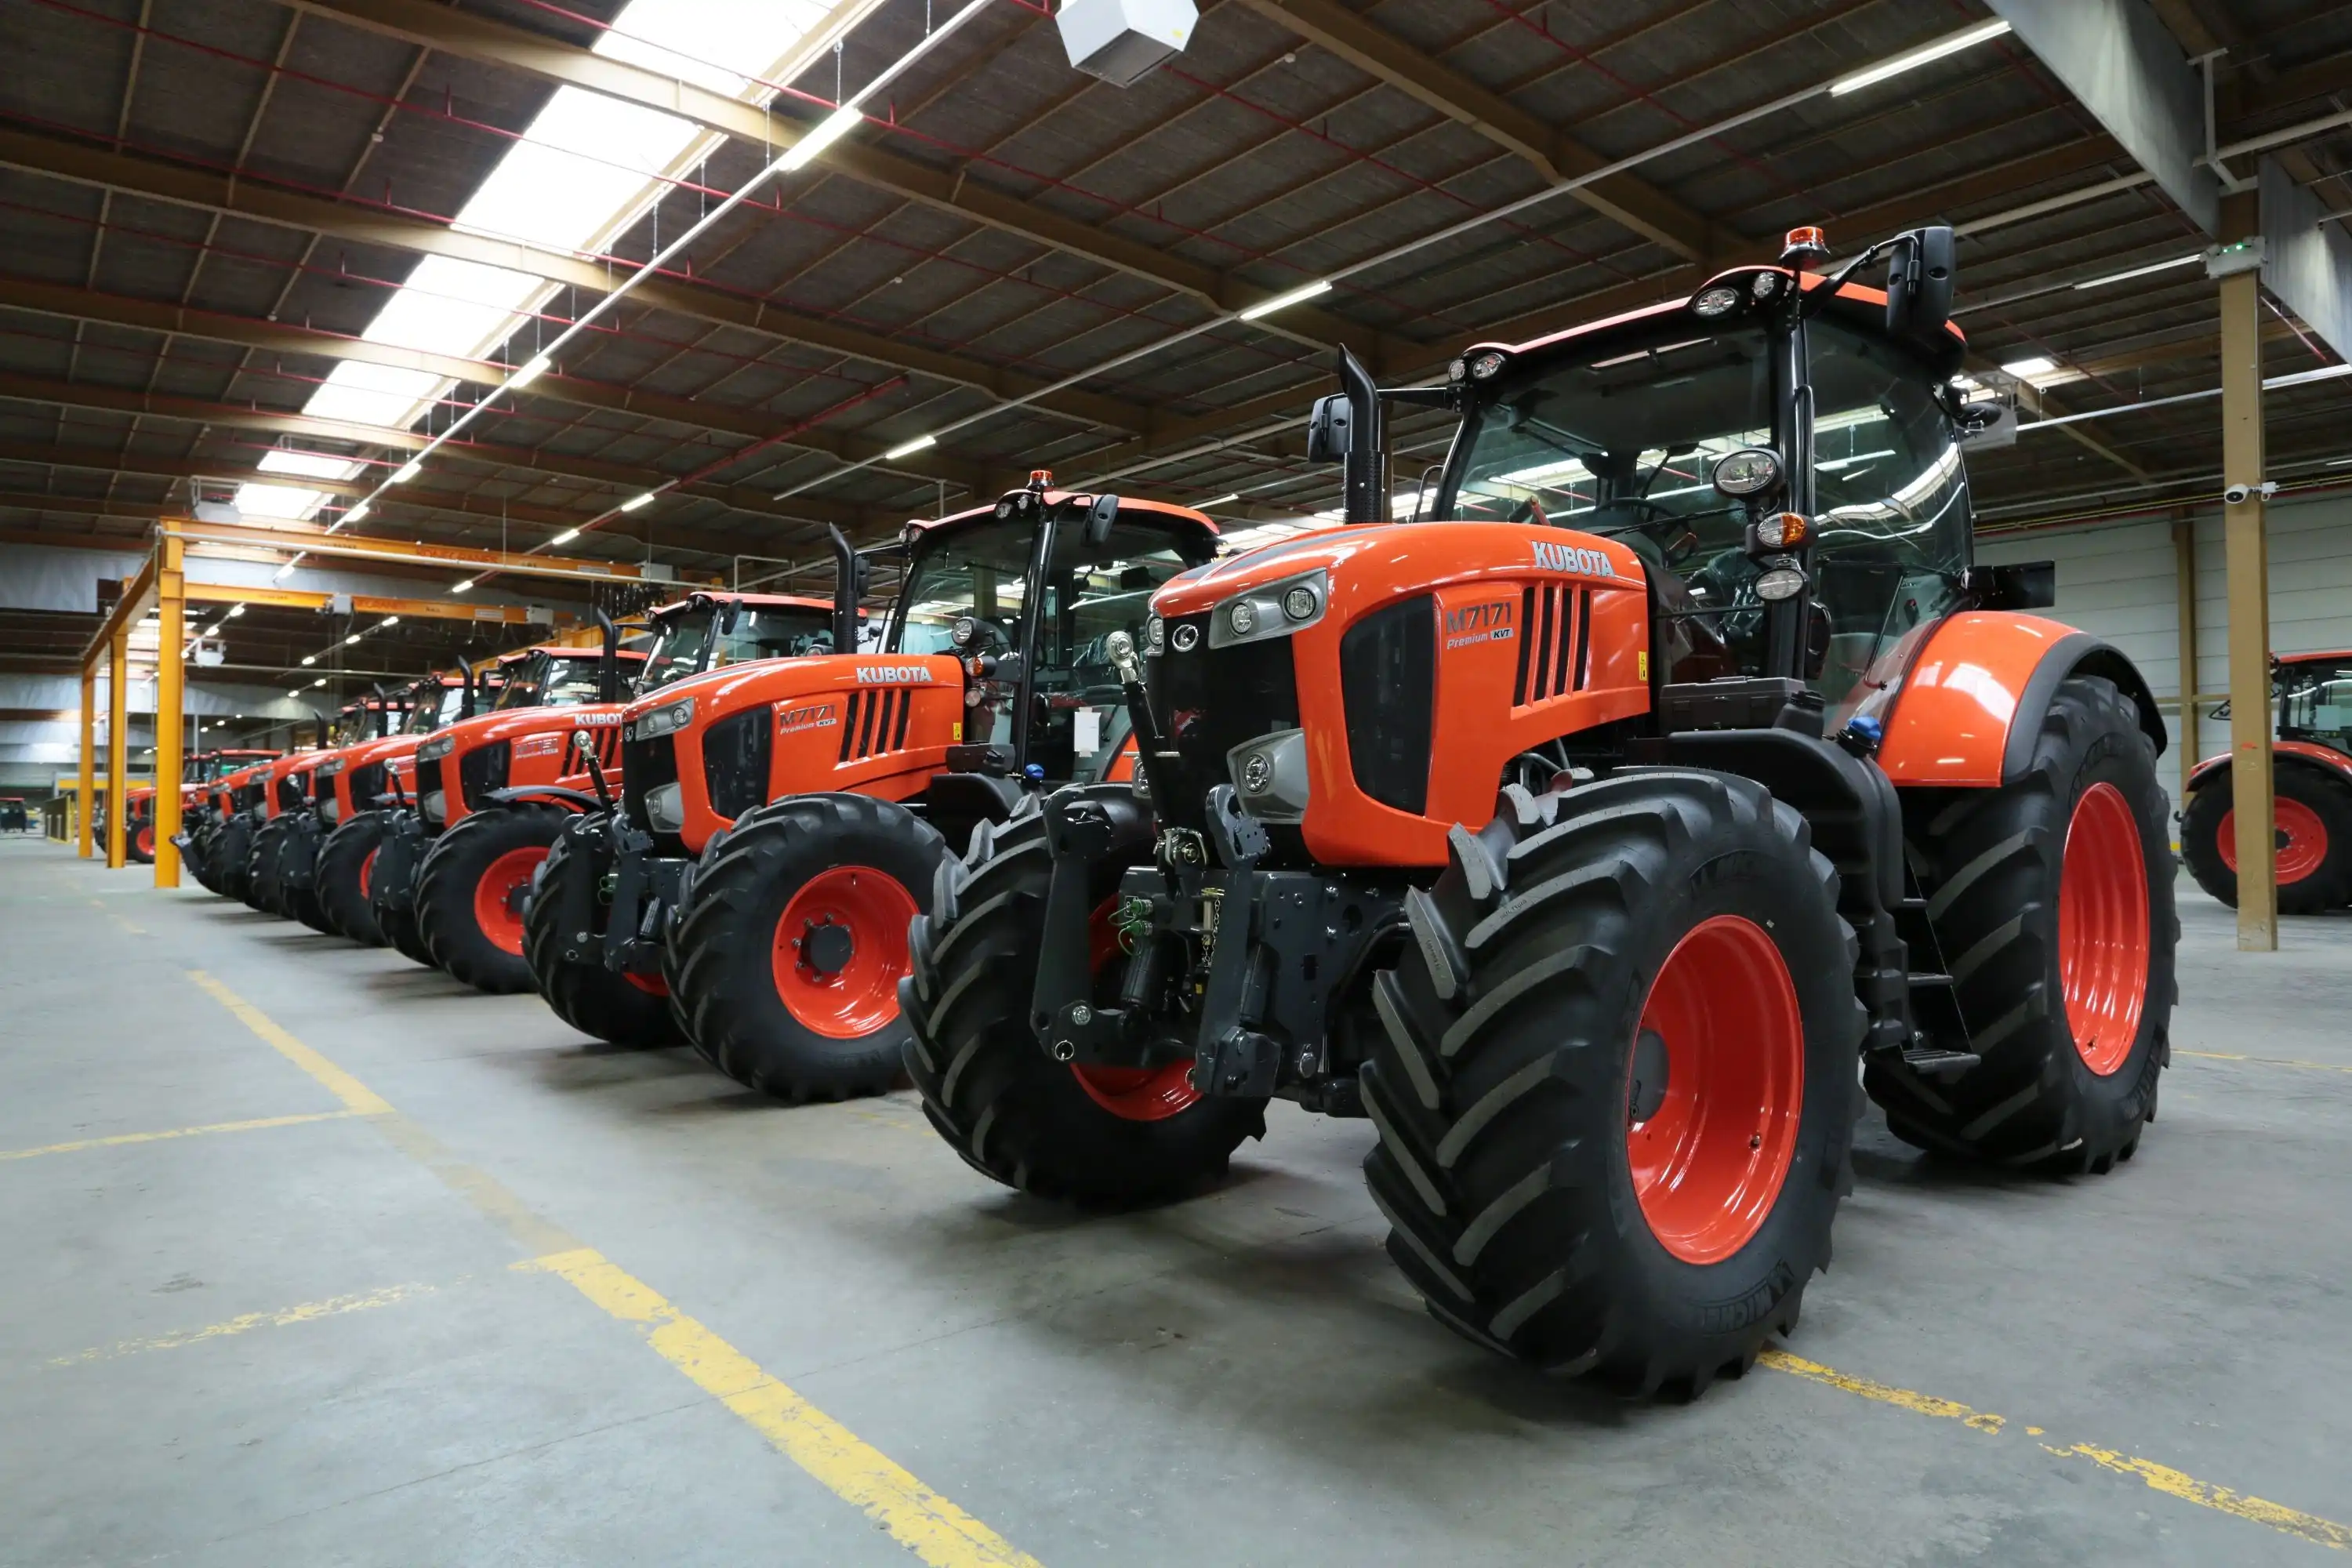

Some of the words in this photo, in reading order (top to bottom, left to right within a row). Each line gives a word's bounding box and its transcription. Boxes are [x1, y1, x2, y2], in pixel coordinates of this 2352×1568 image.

[1531, 540, 1615, 579] KUBOTA
[1446, 601, 1512, 634] M7171
[1446, 633, 1488, 649] Premium
[1492, 628, 1512, 639] KVT
[855, 666, 932, 684] KUBOTA
[575, 713, 622, 725] KUBOT
[779, 704, 835, 727] M7171
[780, 723, 815, 735] Premium
